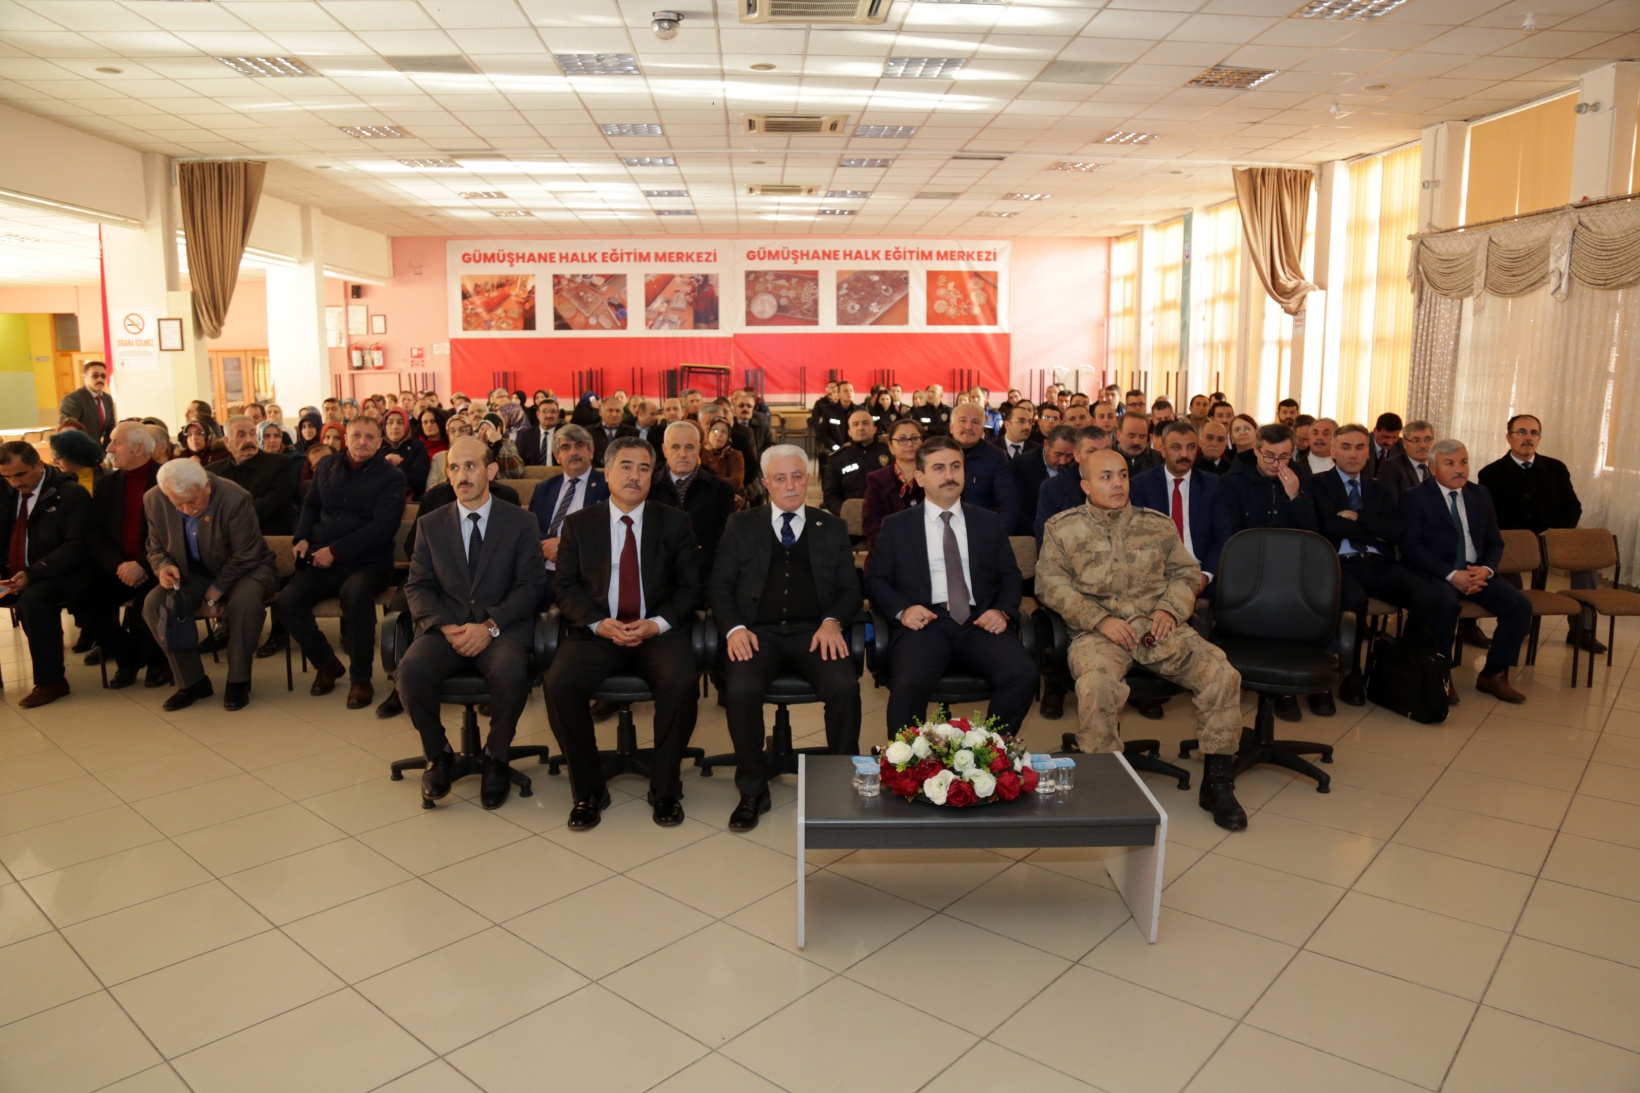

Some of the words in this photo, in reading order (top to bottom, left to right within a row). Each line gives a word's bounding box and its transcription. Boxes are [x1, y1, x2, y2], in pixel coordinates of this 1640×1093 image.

[461, 249, 555, 267] GÜMÜŞHANE
[558, 251, 597, 263] HALK
[601, 248, 652, 263] EĞİTİM
[654, 248, 718, 263] MERKEZİ
[745, 246, 840, 264] GÜMÜŞHANE
[843, 249, 881, 261] HALK
[884, 246, 934, 261] EĞİTİM
[936, 248, 998, 262] MERKEZİ
